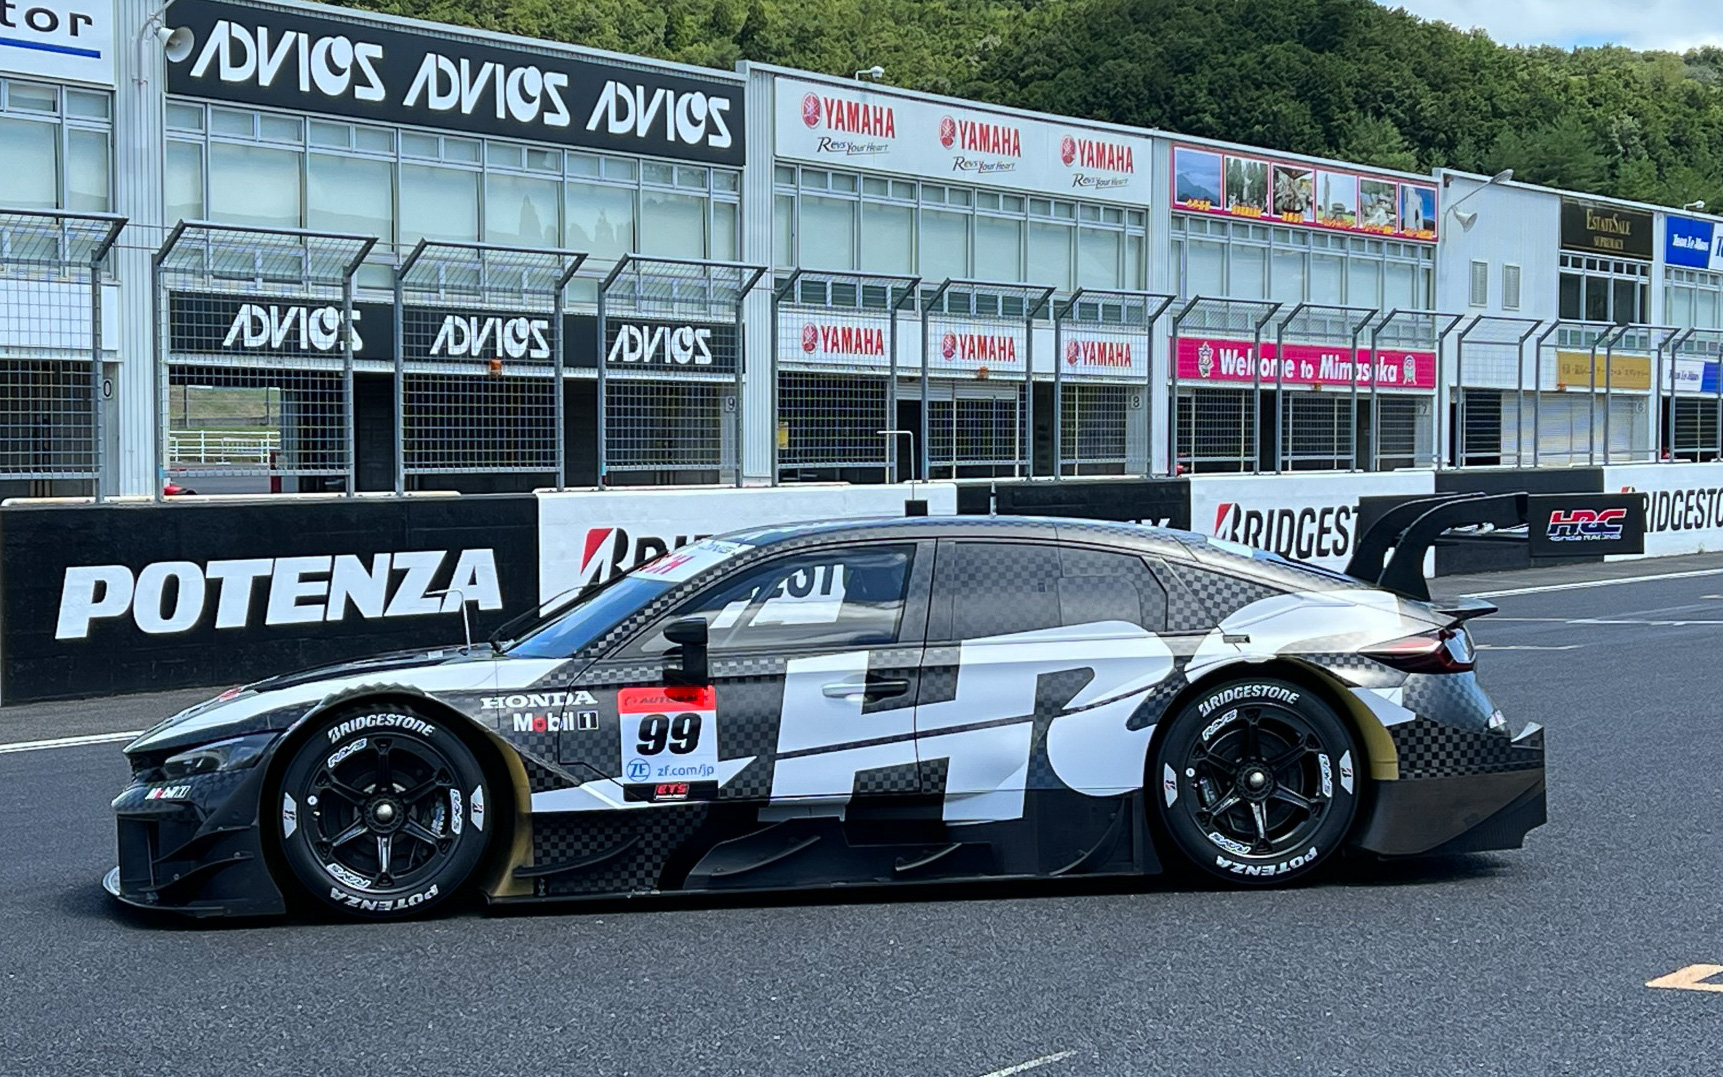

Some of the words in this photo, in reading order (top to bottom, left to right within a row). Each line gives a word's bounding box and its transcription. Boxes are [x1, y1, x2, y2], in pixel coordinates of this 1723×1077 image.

[190, 20, 386, 102] ADVICS
[403, 53, 571, 127] ADVICS
[586, 80, 733, 149] ADVICS
[824, 97, 896, 139] YAMAHA
[959, 119, 1022, 157] YAMAHA
[1078, 138, 1134, 173] YAMAHA
[223, 304, 363, 351] ADVICS
[430, 314, 550, 358] ADVICS
[821, 325, 885, 355] YAMAHA
[608, 325, 712, 365] ADVICS
[957, 333, 1016, 363] YAMAHA
[1081, 341, 1132, 367] YAMAHA
[1300, 360, 1314, 379] to
[727, 397, 735, 410] 9
[1547, 508, 1628, 536] HRC
[55, 549, 503, 639] POTENZA
[480, 690, 598, 709] HONDA
[1198, 685, 1300, 717] BRIDGESTONE
[327, 713, 436, 743] BRIDGESTONE
[513, 711, 575, 732] Mobil
[636, 712, 702, 756] 99
[657, 764, 714, 777] zf.com/jp
[1216, 847, 1318, 875] POTENZA
[330, 884, 439, 911] POTENZA
